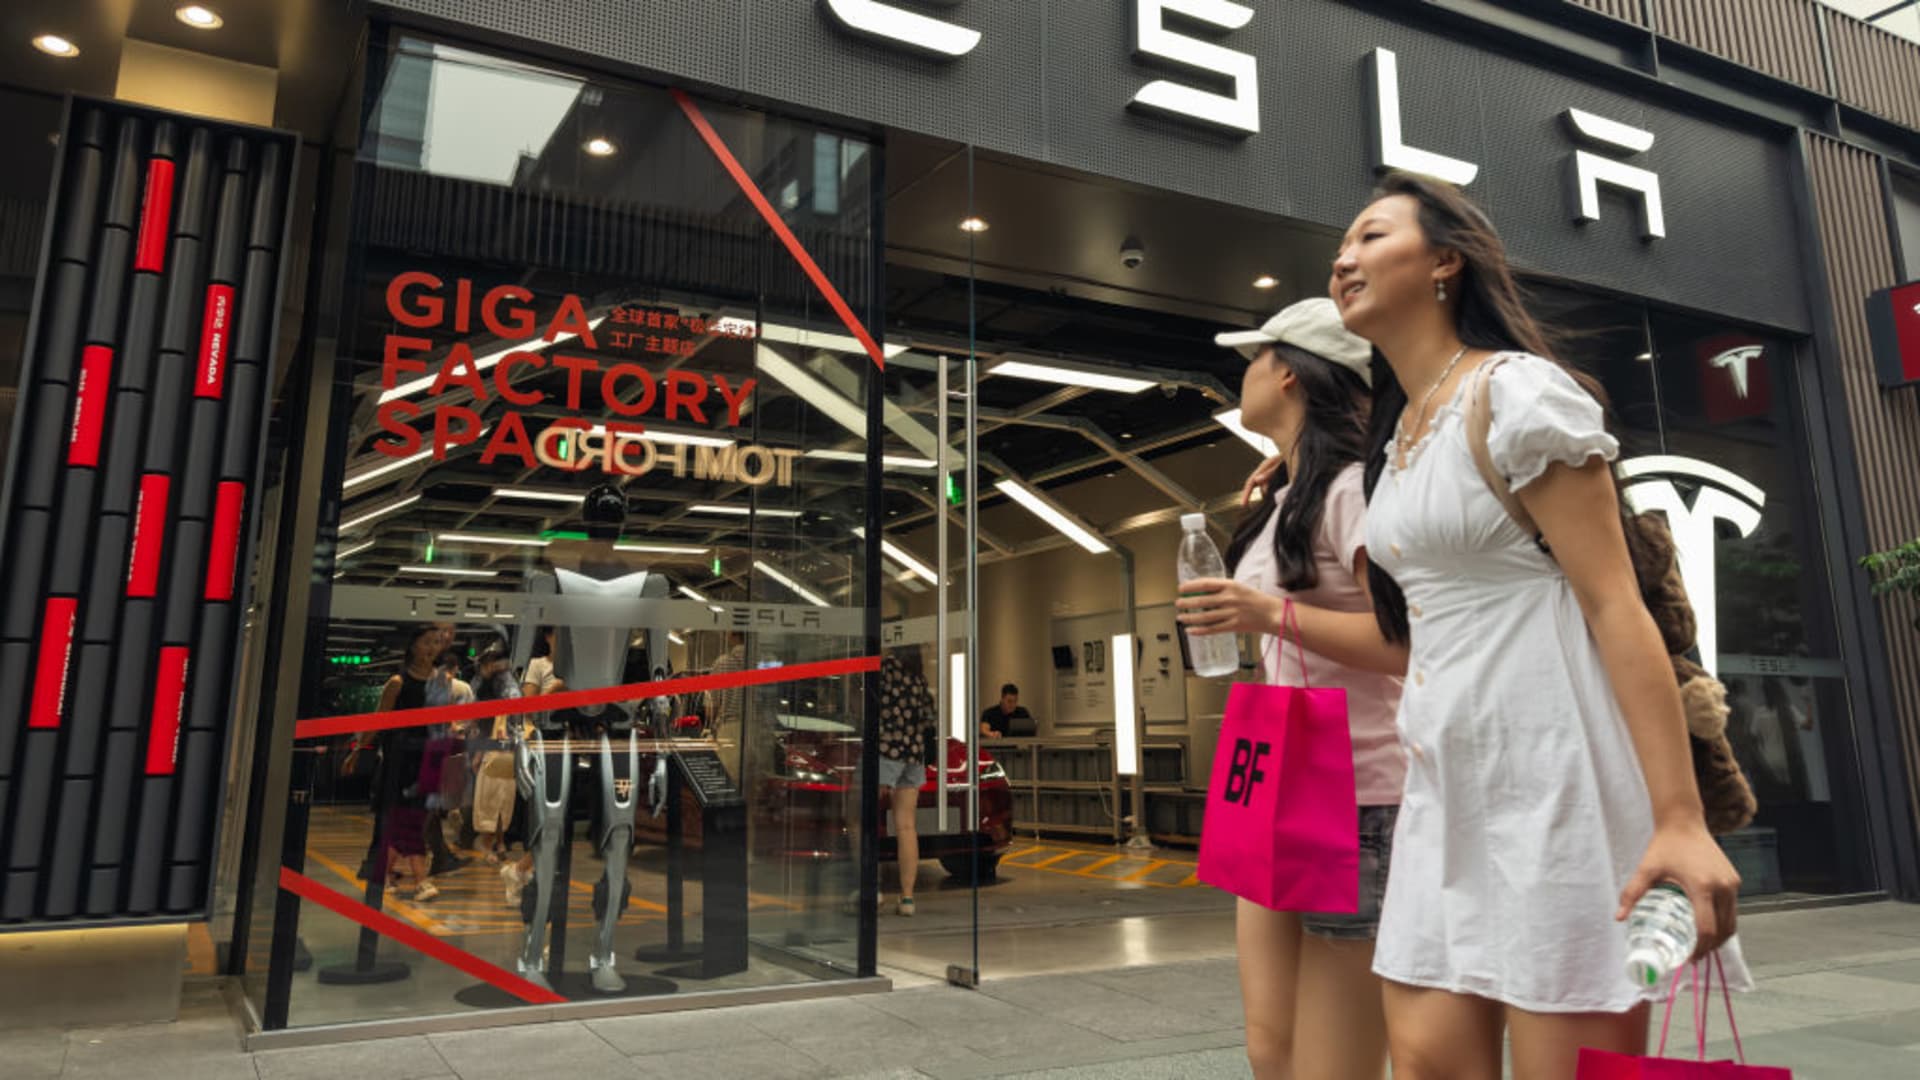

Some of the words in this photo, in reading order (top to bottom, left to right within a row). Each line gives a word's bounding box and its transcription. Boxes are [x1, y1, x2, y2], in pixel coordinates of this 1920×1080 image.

[386, 271, 598, 350] GIGA
[608, 330, 697, 357] 工厂主题店
[207, 332, 221, 385] NEVADA
[381, 334, 757, 427] FACTORY
[373, 400, 645, 476] SPACE
[706, 606, 821, 629] TESLA
[1223, 737, 1271, 807] BF
